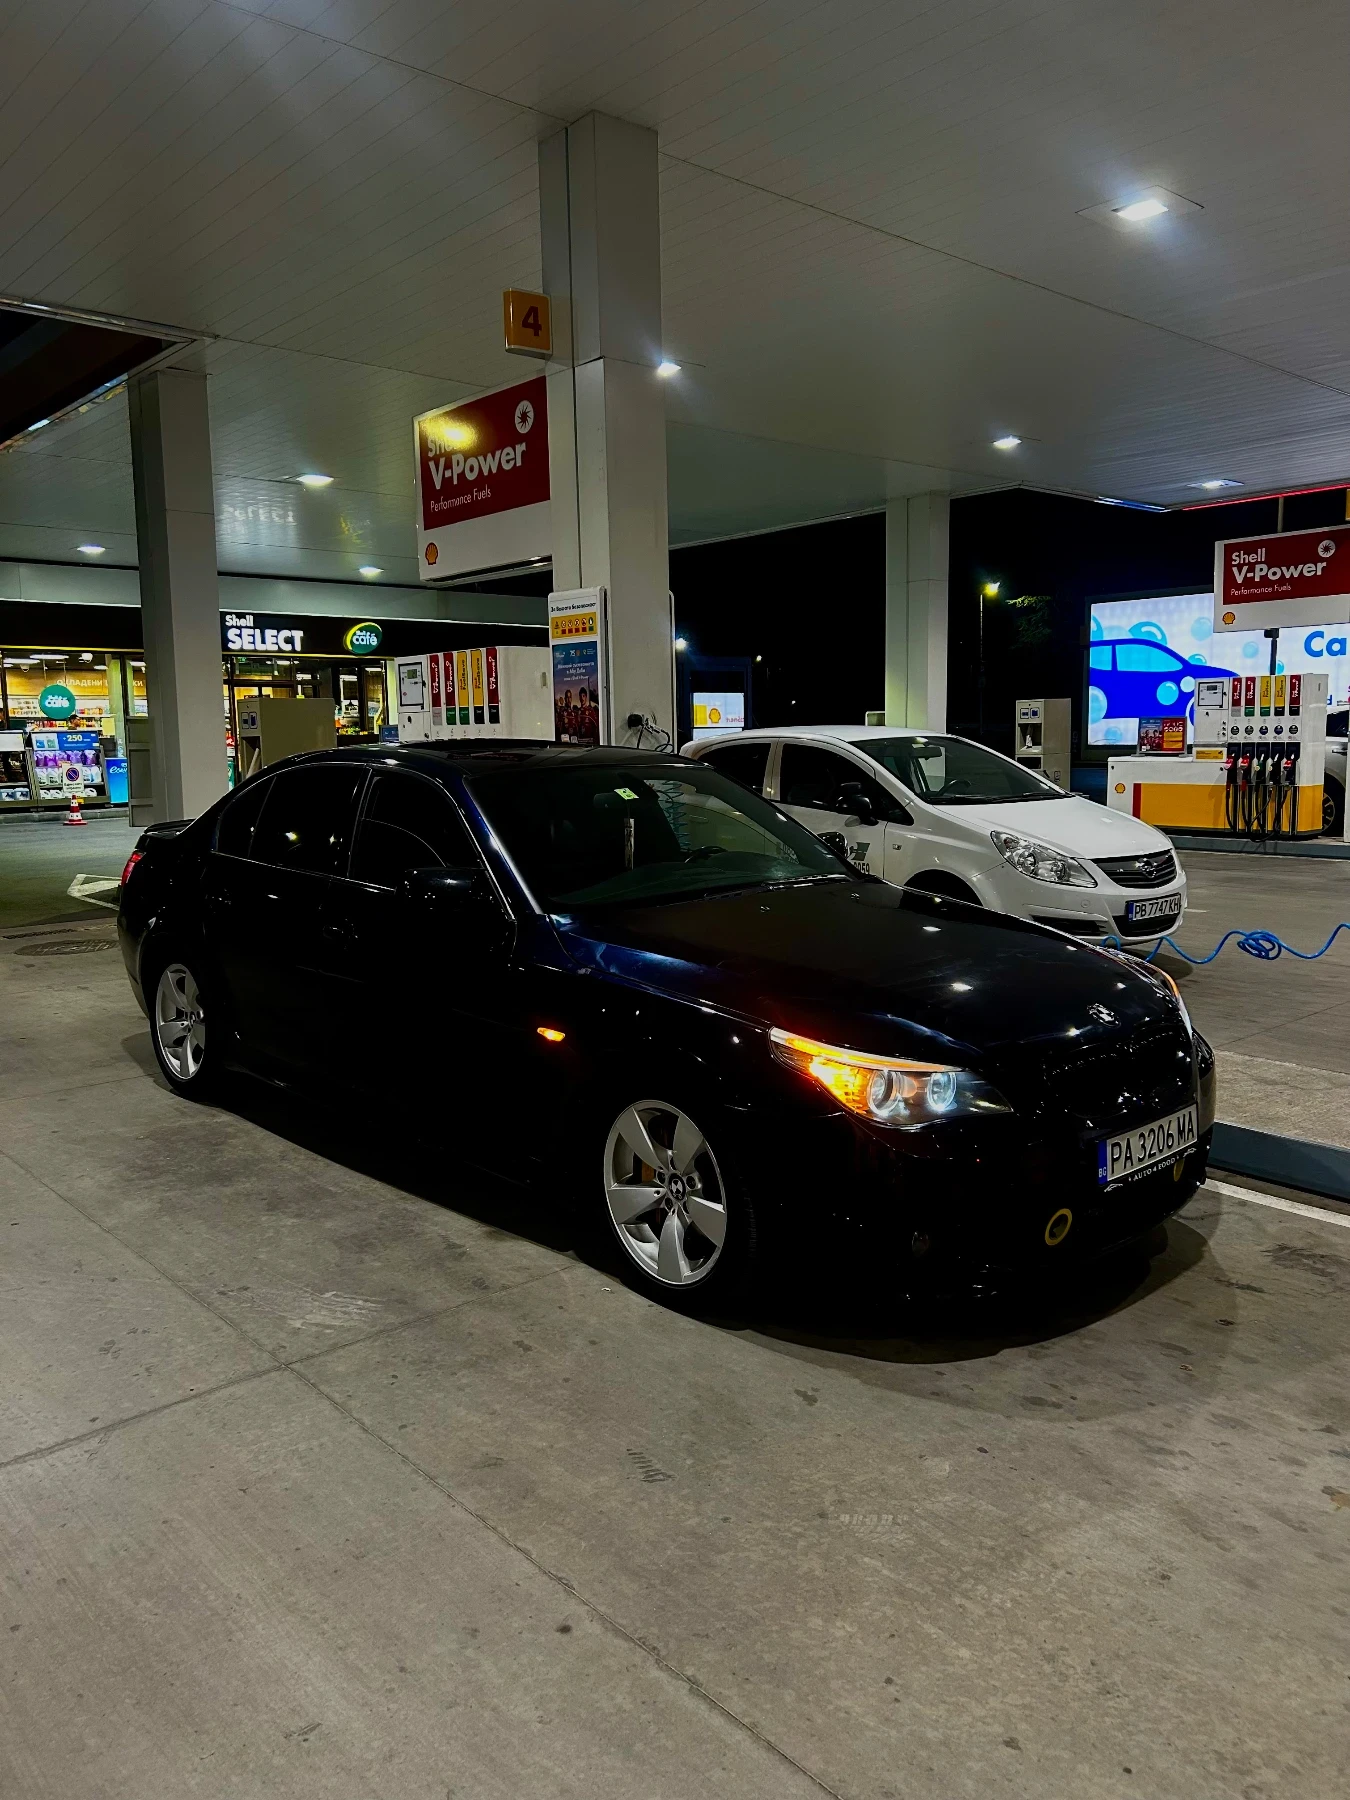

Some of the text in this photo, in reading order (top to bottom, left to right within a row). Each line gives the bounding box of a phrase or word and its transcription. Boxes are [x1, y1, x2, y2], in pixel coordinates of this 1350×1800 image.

[521, 305, 542, 337] 4
[428, 442, 526, 490] V-Power
[430, 484, 492, 512] Performance Fuels
[1231, 547, 1266, 565] Shell
[1231, 561, 1327, 584] V-Power
[1230, 583, 1292, 597] Performance Fuels
[225, 614, 254, 627] Shell
[227, 628, 304, 651] SELECT
[352, 632, 378, 646] café
[1303, 630, 1347, 658] Ca
[1134, 898, 1179, 918] PB 7747 KH
[1110, 1110, 1195, 1174] PA 3206 MA
[1098, 1166, 1107, 1178] BG
[1133, 1168, 1152, 1182] AUTO
